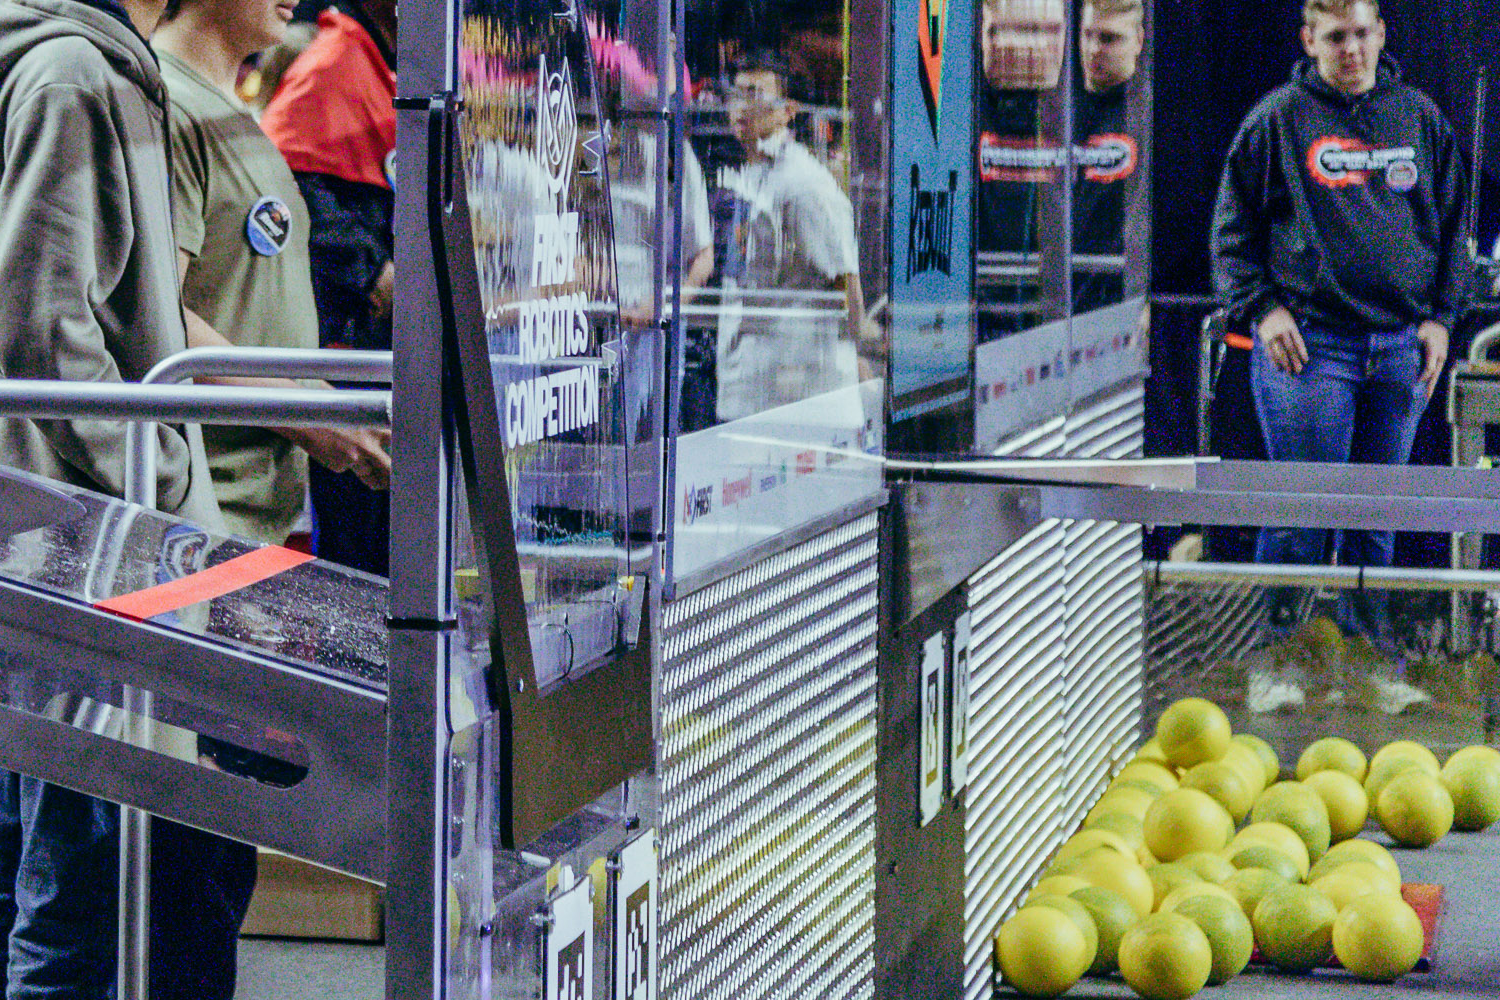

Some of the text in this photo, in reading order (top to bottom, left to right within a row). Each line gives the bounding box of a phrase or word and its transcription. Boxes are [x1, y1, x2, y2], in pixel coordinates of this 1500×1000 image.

[532, 212, 579, 288] FIRST
[519, 291, 589, 366] ROBOTICS
[505, 364, 599, 449] COMPETITION
